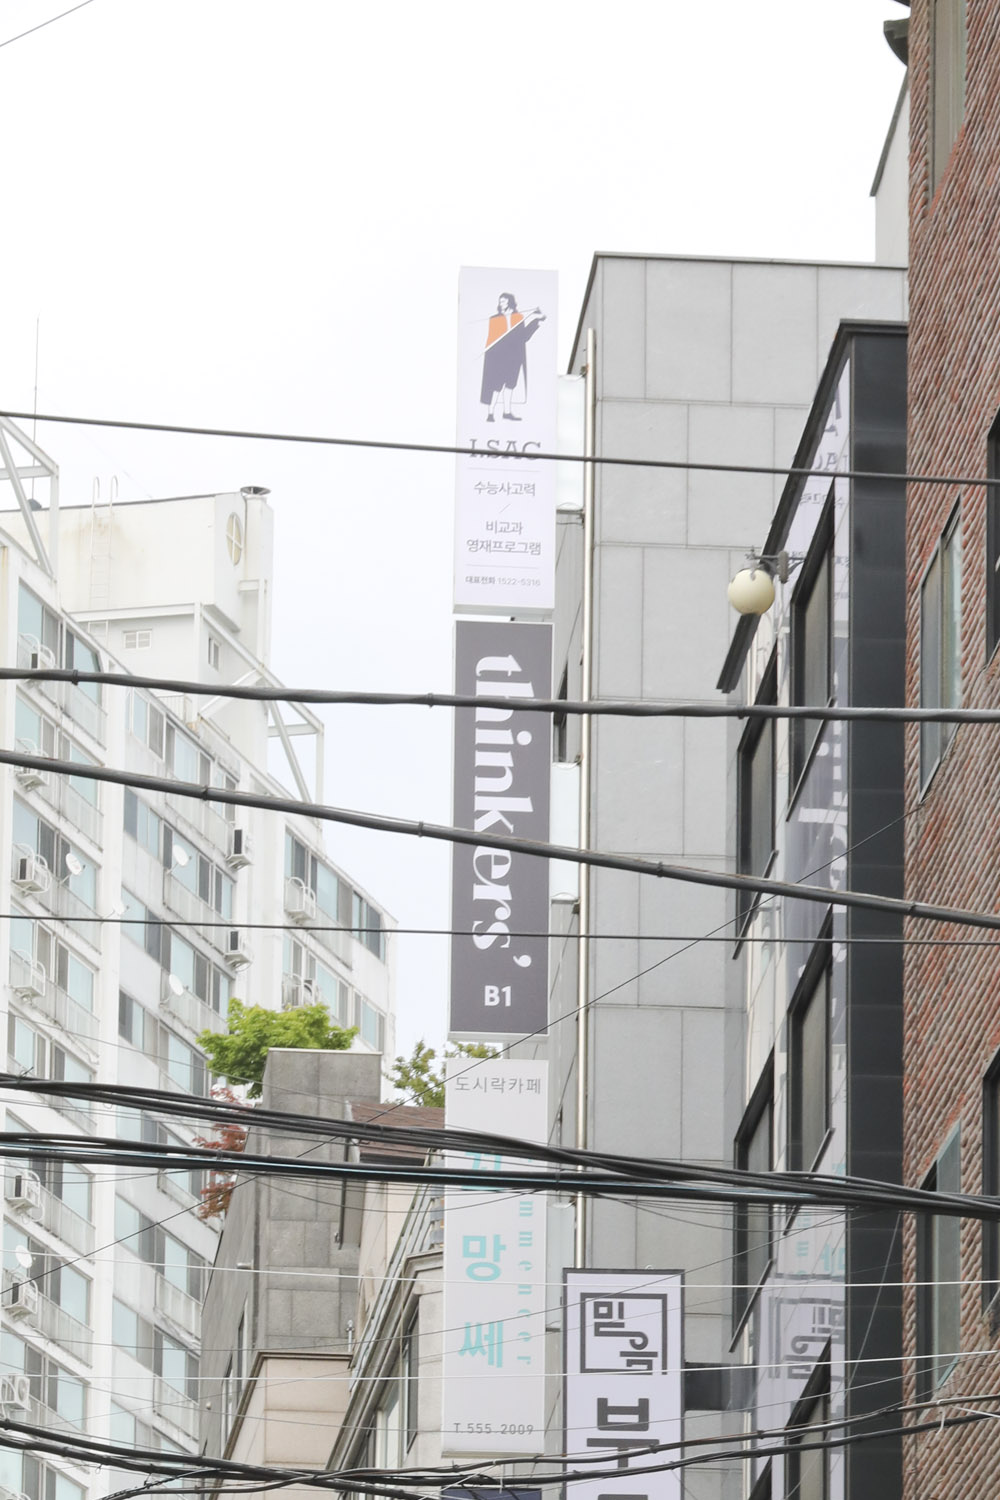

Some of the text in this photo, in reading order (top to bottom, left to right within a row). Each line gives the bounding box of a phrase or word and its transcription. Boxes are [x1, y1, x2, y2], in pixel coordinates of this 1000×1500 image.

[474, 481, 536, 496] 수능사고력
[486, 520, 523, 535] 비교과
[466, 539, 541, 556] 영재프로그램
[465, 575, 495, 585] 대표전화
[484, 985, 512, 1007] B1
[455, 1076, 541, 1095] 도시락카페
